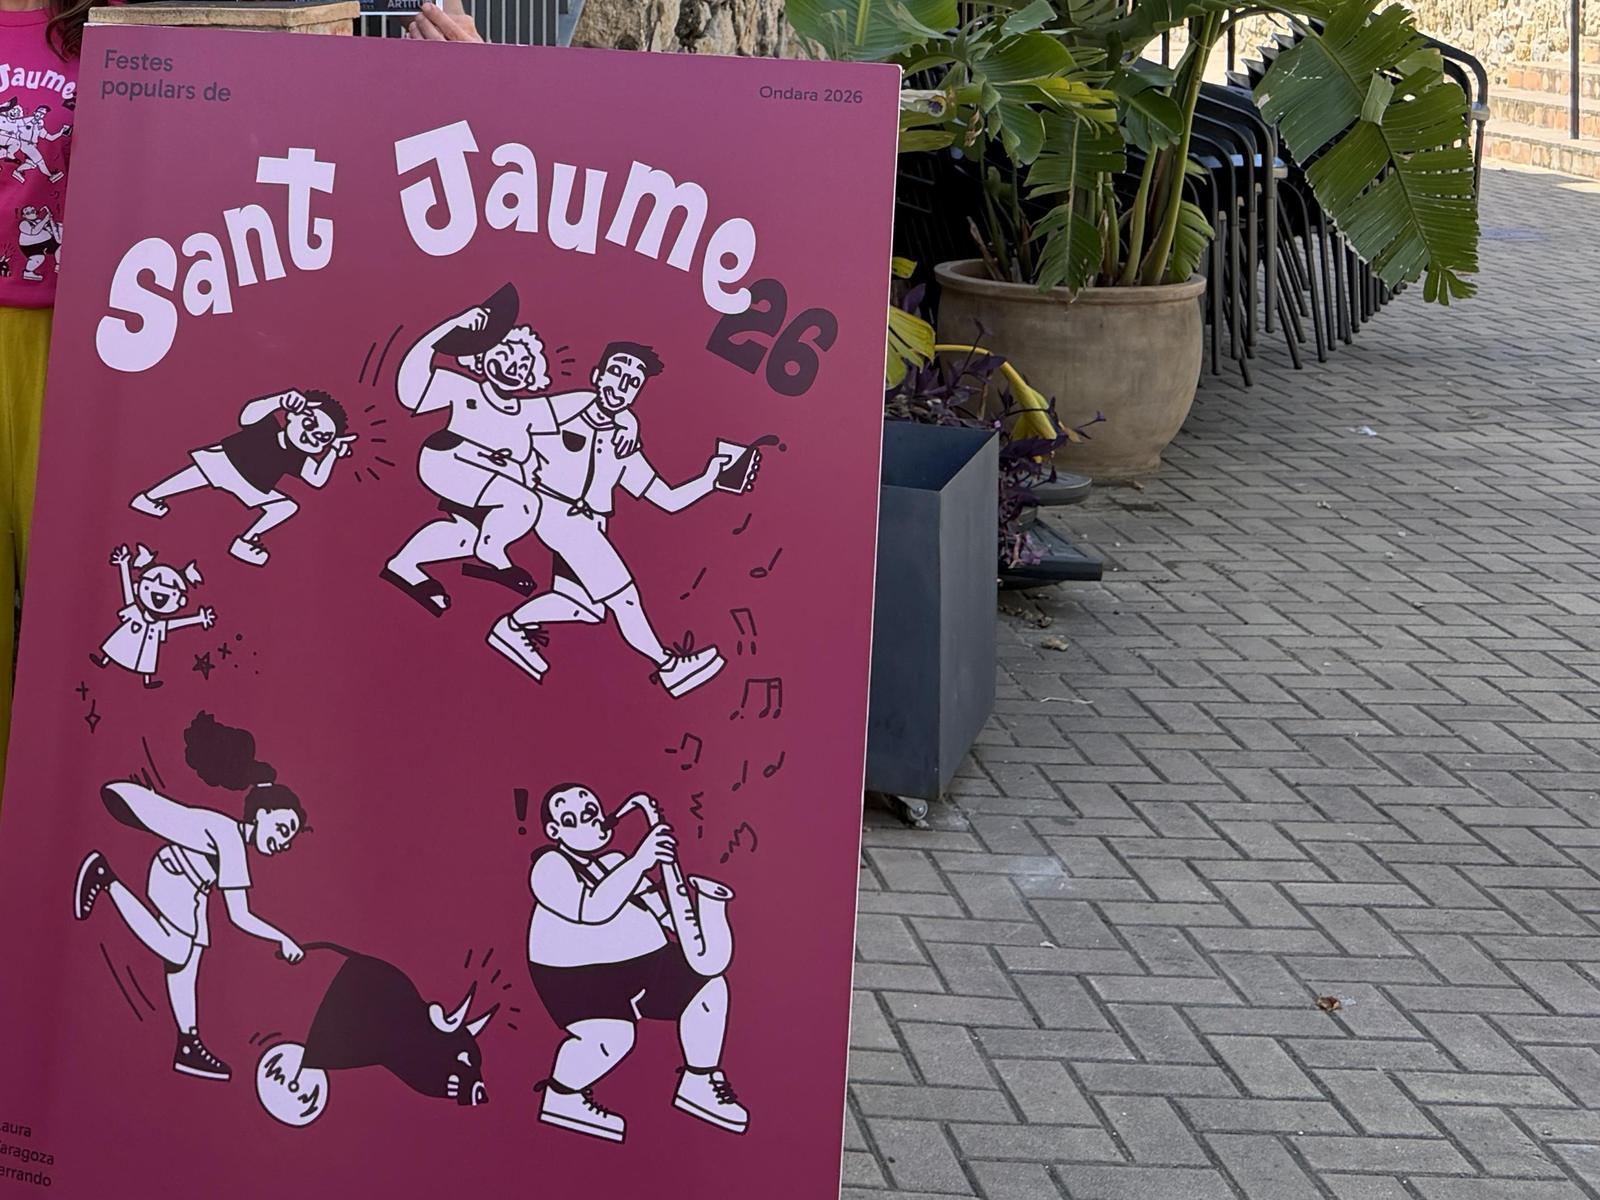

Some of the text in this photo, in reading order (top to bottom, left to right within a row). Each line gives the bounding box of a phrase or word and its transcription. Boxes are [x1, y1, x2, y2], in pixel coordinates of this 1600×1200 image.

[104, 49, 174, 72] Festes
[101, 79, 231, 102] populars de
[759, 86, 863, 104] Ondara 2026
[95, 119, 838, 397] Sant Jaume 26
